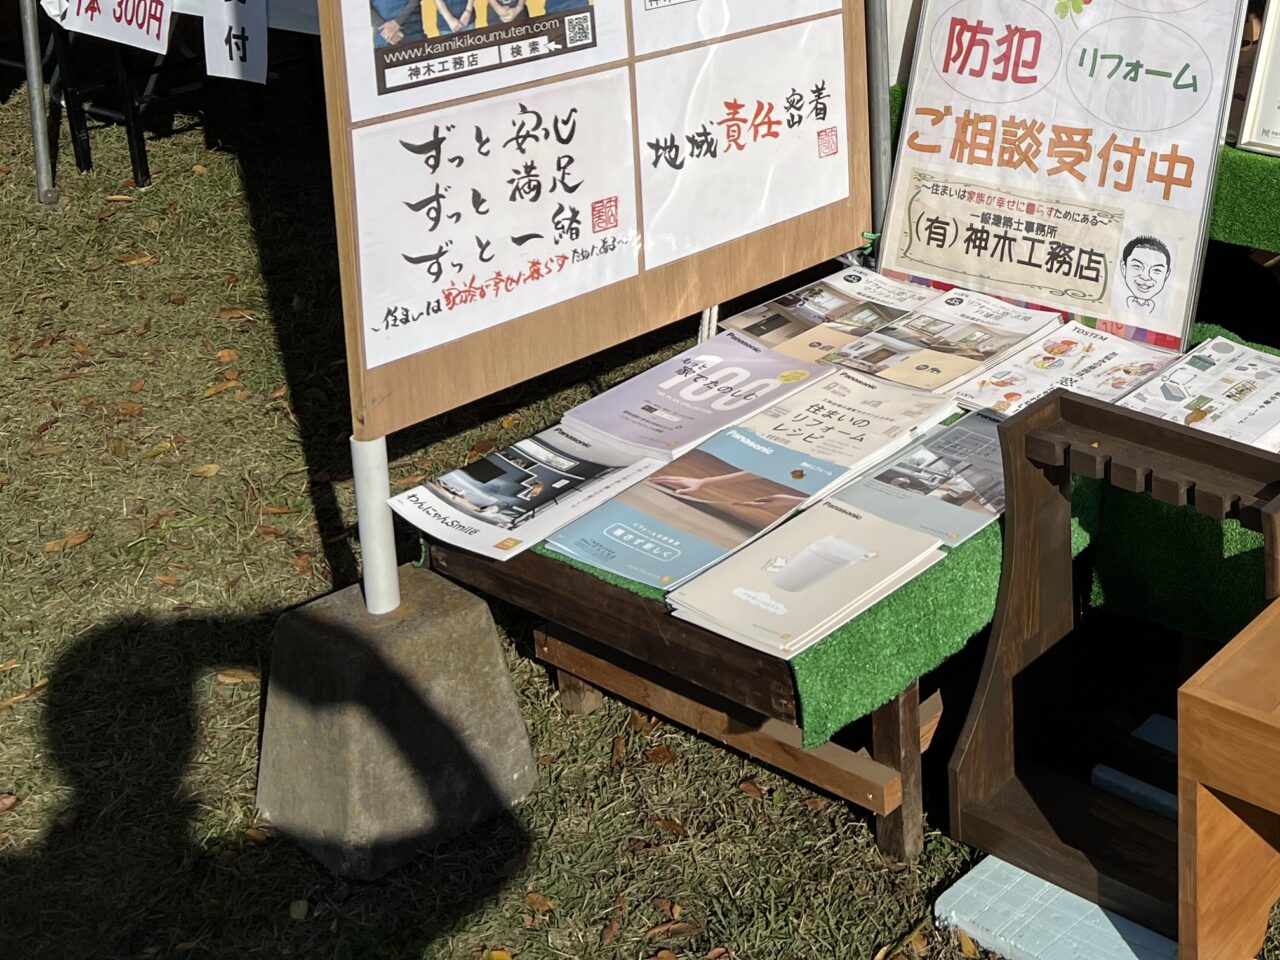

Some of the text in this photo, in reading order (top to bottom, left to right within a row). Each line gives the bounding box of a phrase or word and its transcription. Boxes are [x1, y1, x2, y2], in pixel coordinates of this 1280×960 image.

[384, 18, 560, 64] www.kamikikoumuten.com
[942, 16, 1042, 86] 防犯
[407, 53, 479, 80] 神木工務店
[1078, 48, 1199, 93] リフォーム
[907, 105, 1196, 202] ご相談受付中
[726, 332, 762, 354] Panasonic
[1071, 326, 1108, 342] TOSTEM
[674, 365, 761, 402] 家でたのしむ
[840, 371, 877, 390] Panasonic
[791, 413, 866, 443] リフォーム
[805, 403, 872, 429] 住まいの
[553, 427, 593, 448] Panasonic
[726, 429, 774, 456] Panasonic
[772, 423, 824, 443] レシピ
[822, 500, 863, 521] Panasonic
